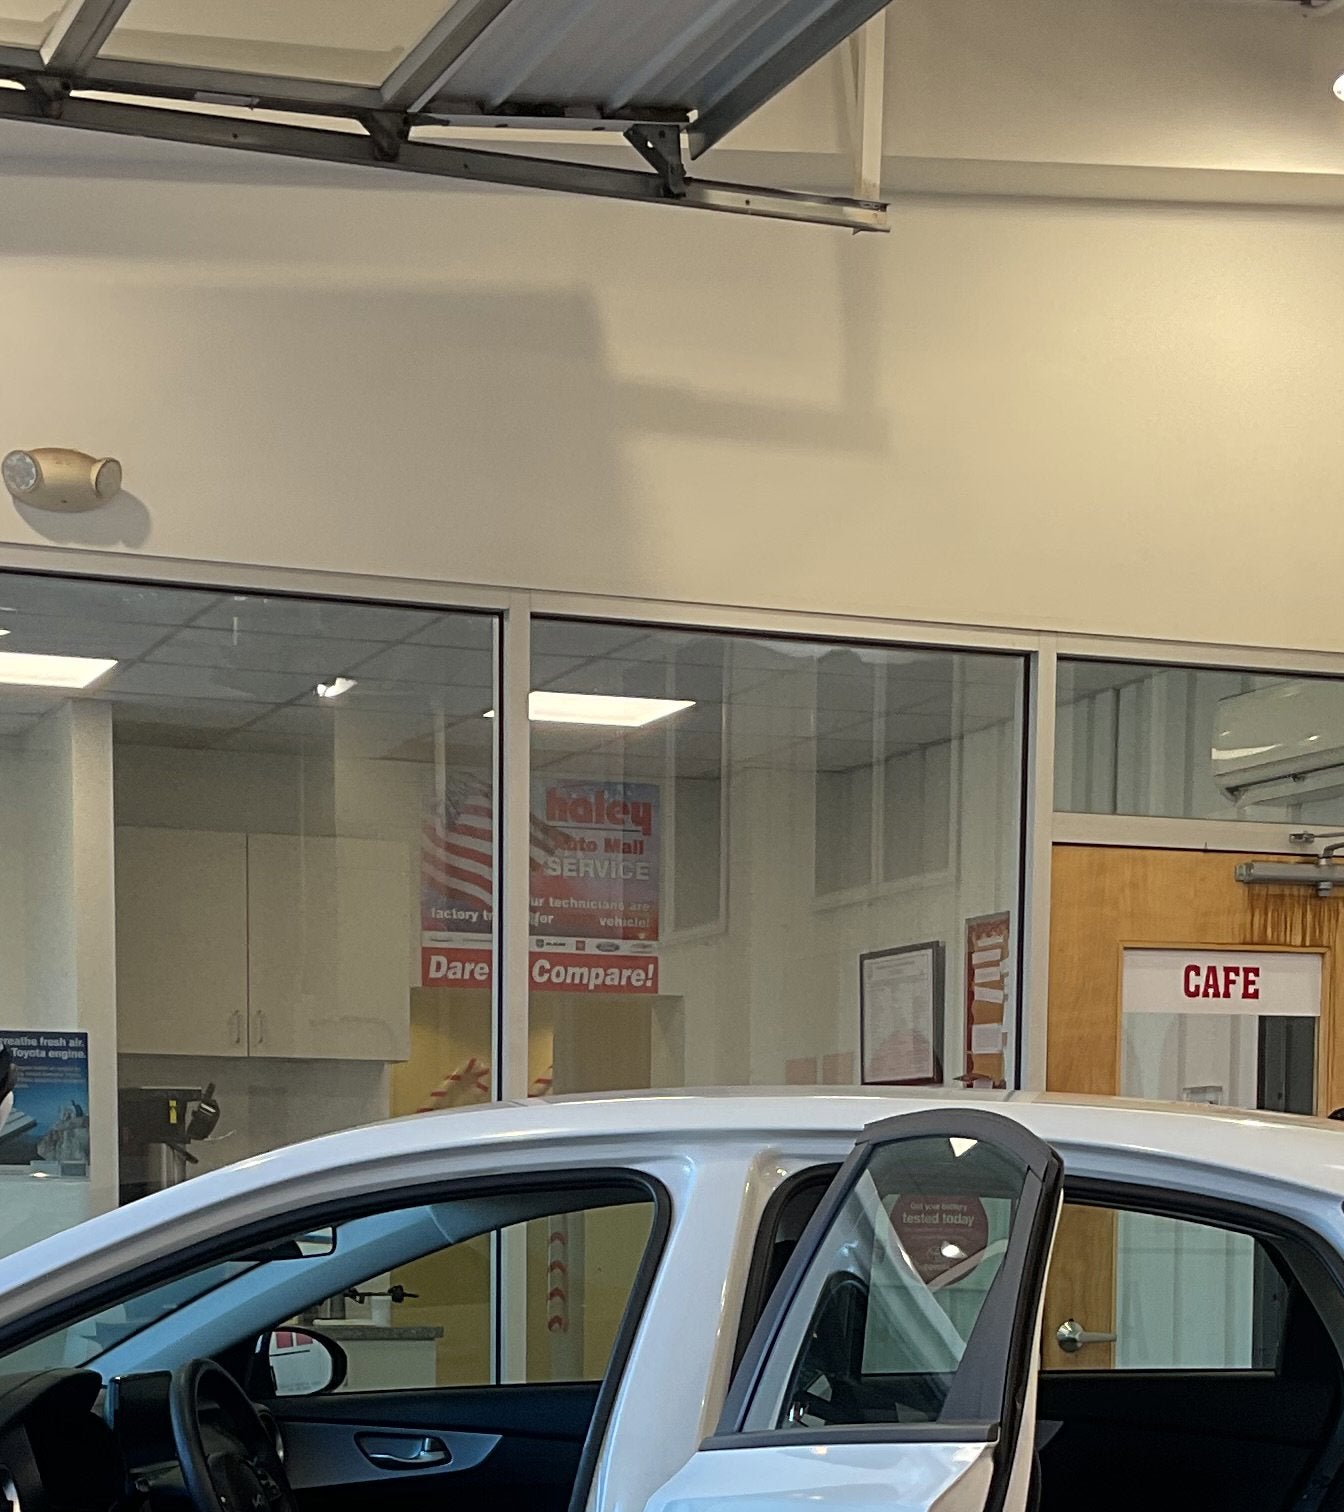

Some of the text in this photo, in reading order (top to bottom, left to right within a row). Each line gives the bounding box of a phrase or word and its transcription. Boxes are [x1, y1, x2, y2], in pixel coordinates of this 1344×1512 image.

[546, 787, 652, 836] haley
[604, 838, 644, 856] Mall
[544, 856, 650, 881] SERVICE
[549, 896, 625, 912] technicians
[630, 901, 650, 912] are
[431, 907, 479, 922] factory
[429, 955, 655, 990] Dare Compare!
[1183, 964, 1260, 1000] CAFE
[40, 1037, 67, 1047] fresh
[68, 1038, 85, 1047] air.
[11, 1048, 46, 1059] Toyota
[48, 1049, 87, 1060] engine.
[903, 1213, 975, 1227] tested today
